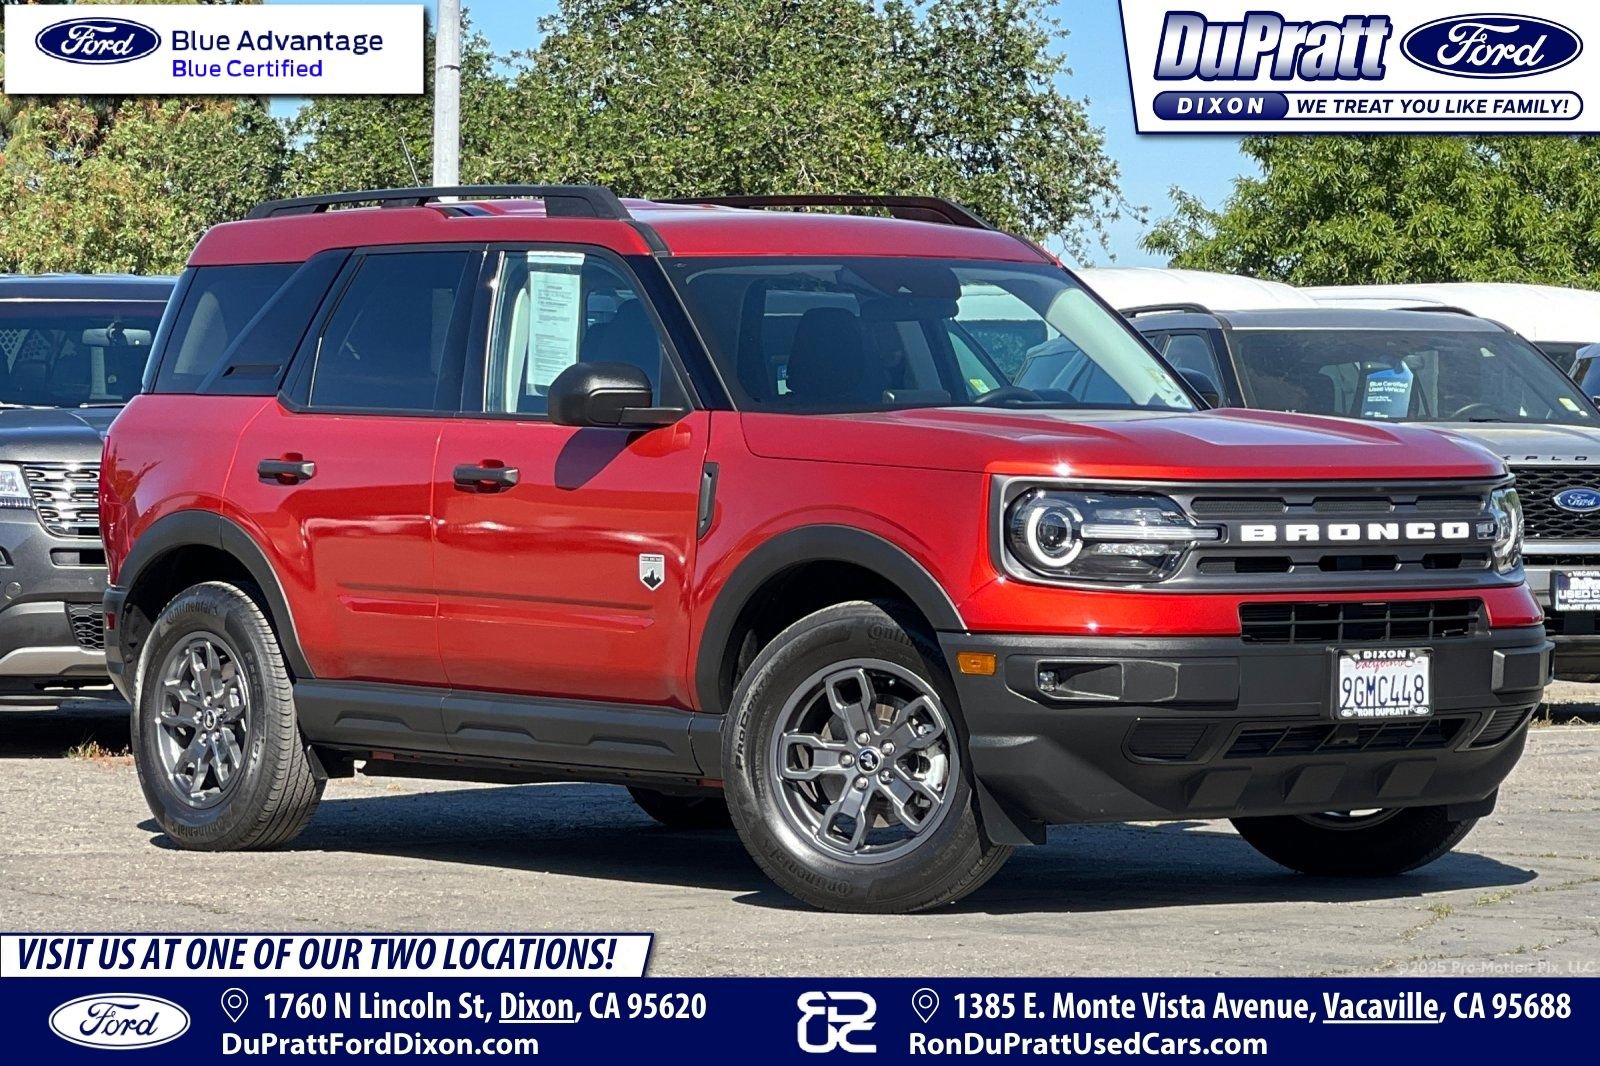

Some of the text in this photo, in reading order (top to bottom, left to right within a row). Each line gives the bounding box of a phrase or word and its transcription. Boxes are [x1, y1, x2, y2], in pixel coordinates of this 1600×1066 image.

[1240, 521, 1470, 542] BRONCO
[1363, 650, 1407, 660] DIXON
[1342, 674, 1424, 708] 9GMC448
[1358, 707, 1373, 718] RON
[1375, 706, 1410, 717] DUPRATT
